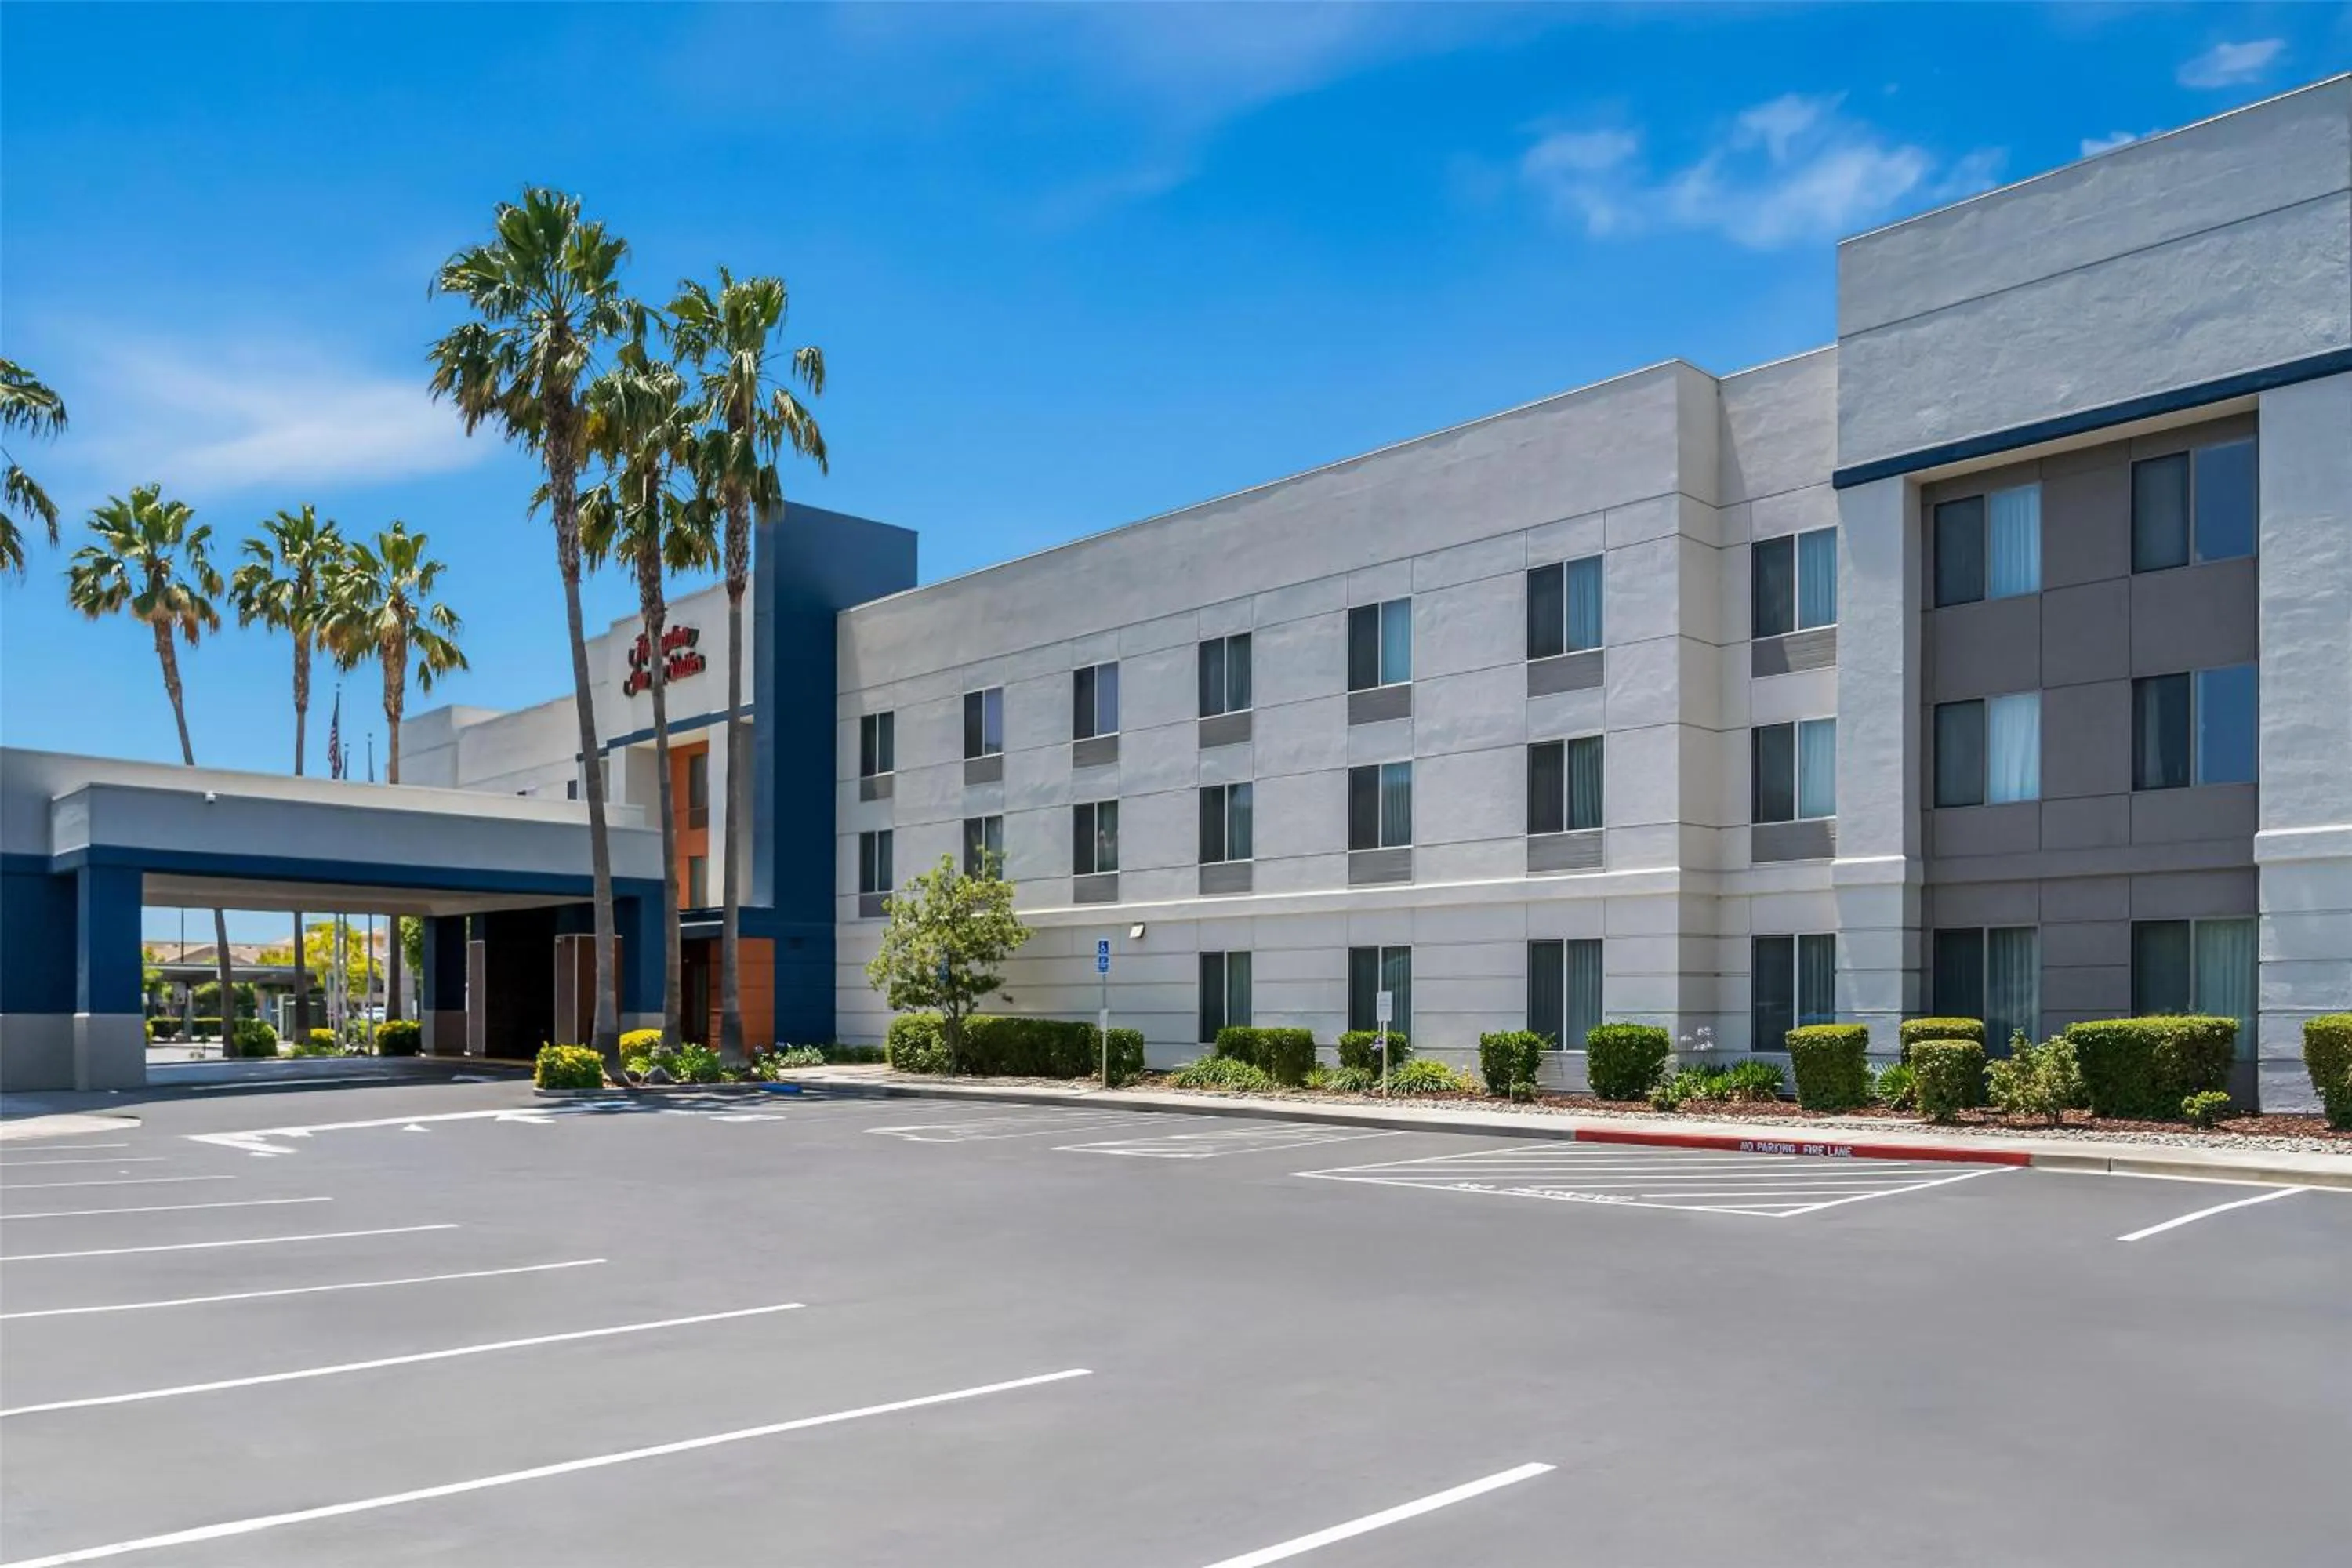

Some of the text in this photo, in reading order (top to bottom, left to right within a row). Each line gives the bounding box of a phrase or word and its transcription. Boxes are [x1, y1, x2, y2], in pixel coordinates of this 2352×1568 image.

[1740, 1141, 1853, 1157] NO PARKING FIRE LANE
